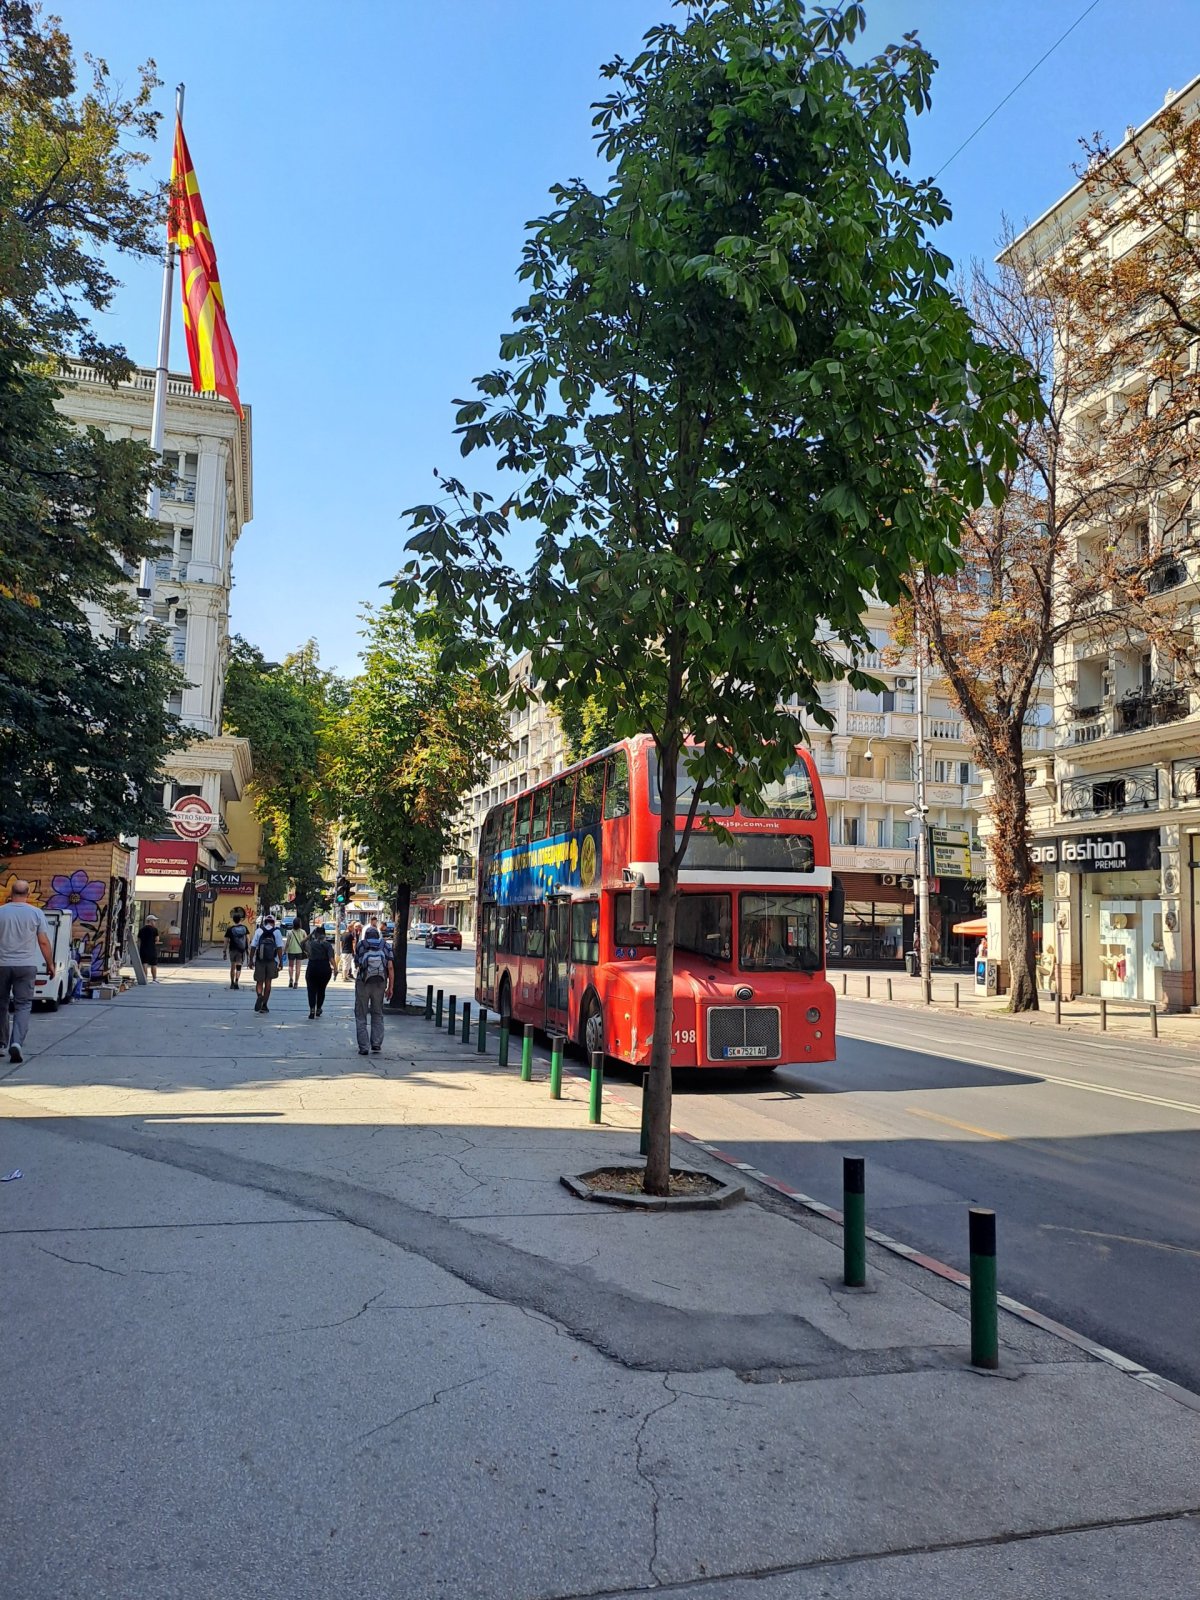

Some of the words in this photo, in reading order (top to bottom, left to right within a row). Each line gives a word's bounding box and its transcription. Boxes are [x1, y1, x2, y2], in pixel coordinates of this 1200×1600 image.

[172, 813, 194, 821] ASTRO
[700, 820, 780, 829] w.jsp.com.mk
[1061, 837, 1126, 861] fashion
[1094, 860, 1126, 870] PREMIUM
[210, 874, 240, 883] KVIN
[674, 1029, 697, 1044] 198
[728, 1048, 736, 1056] SK
[740, 1047, 757, 1056] 7521
